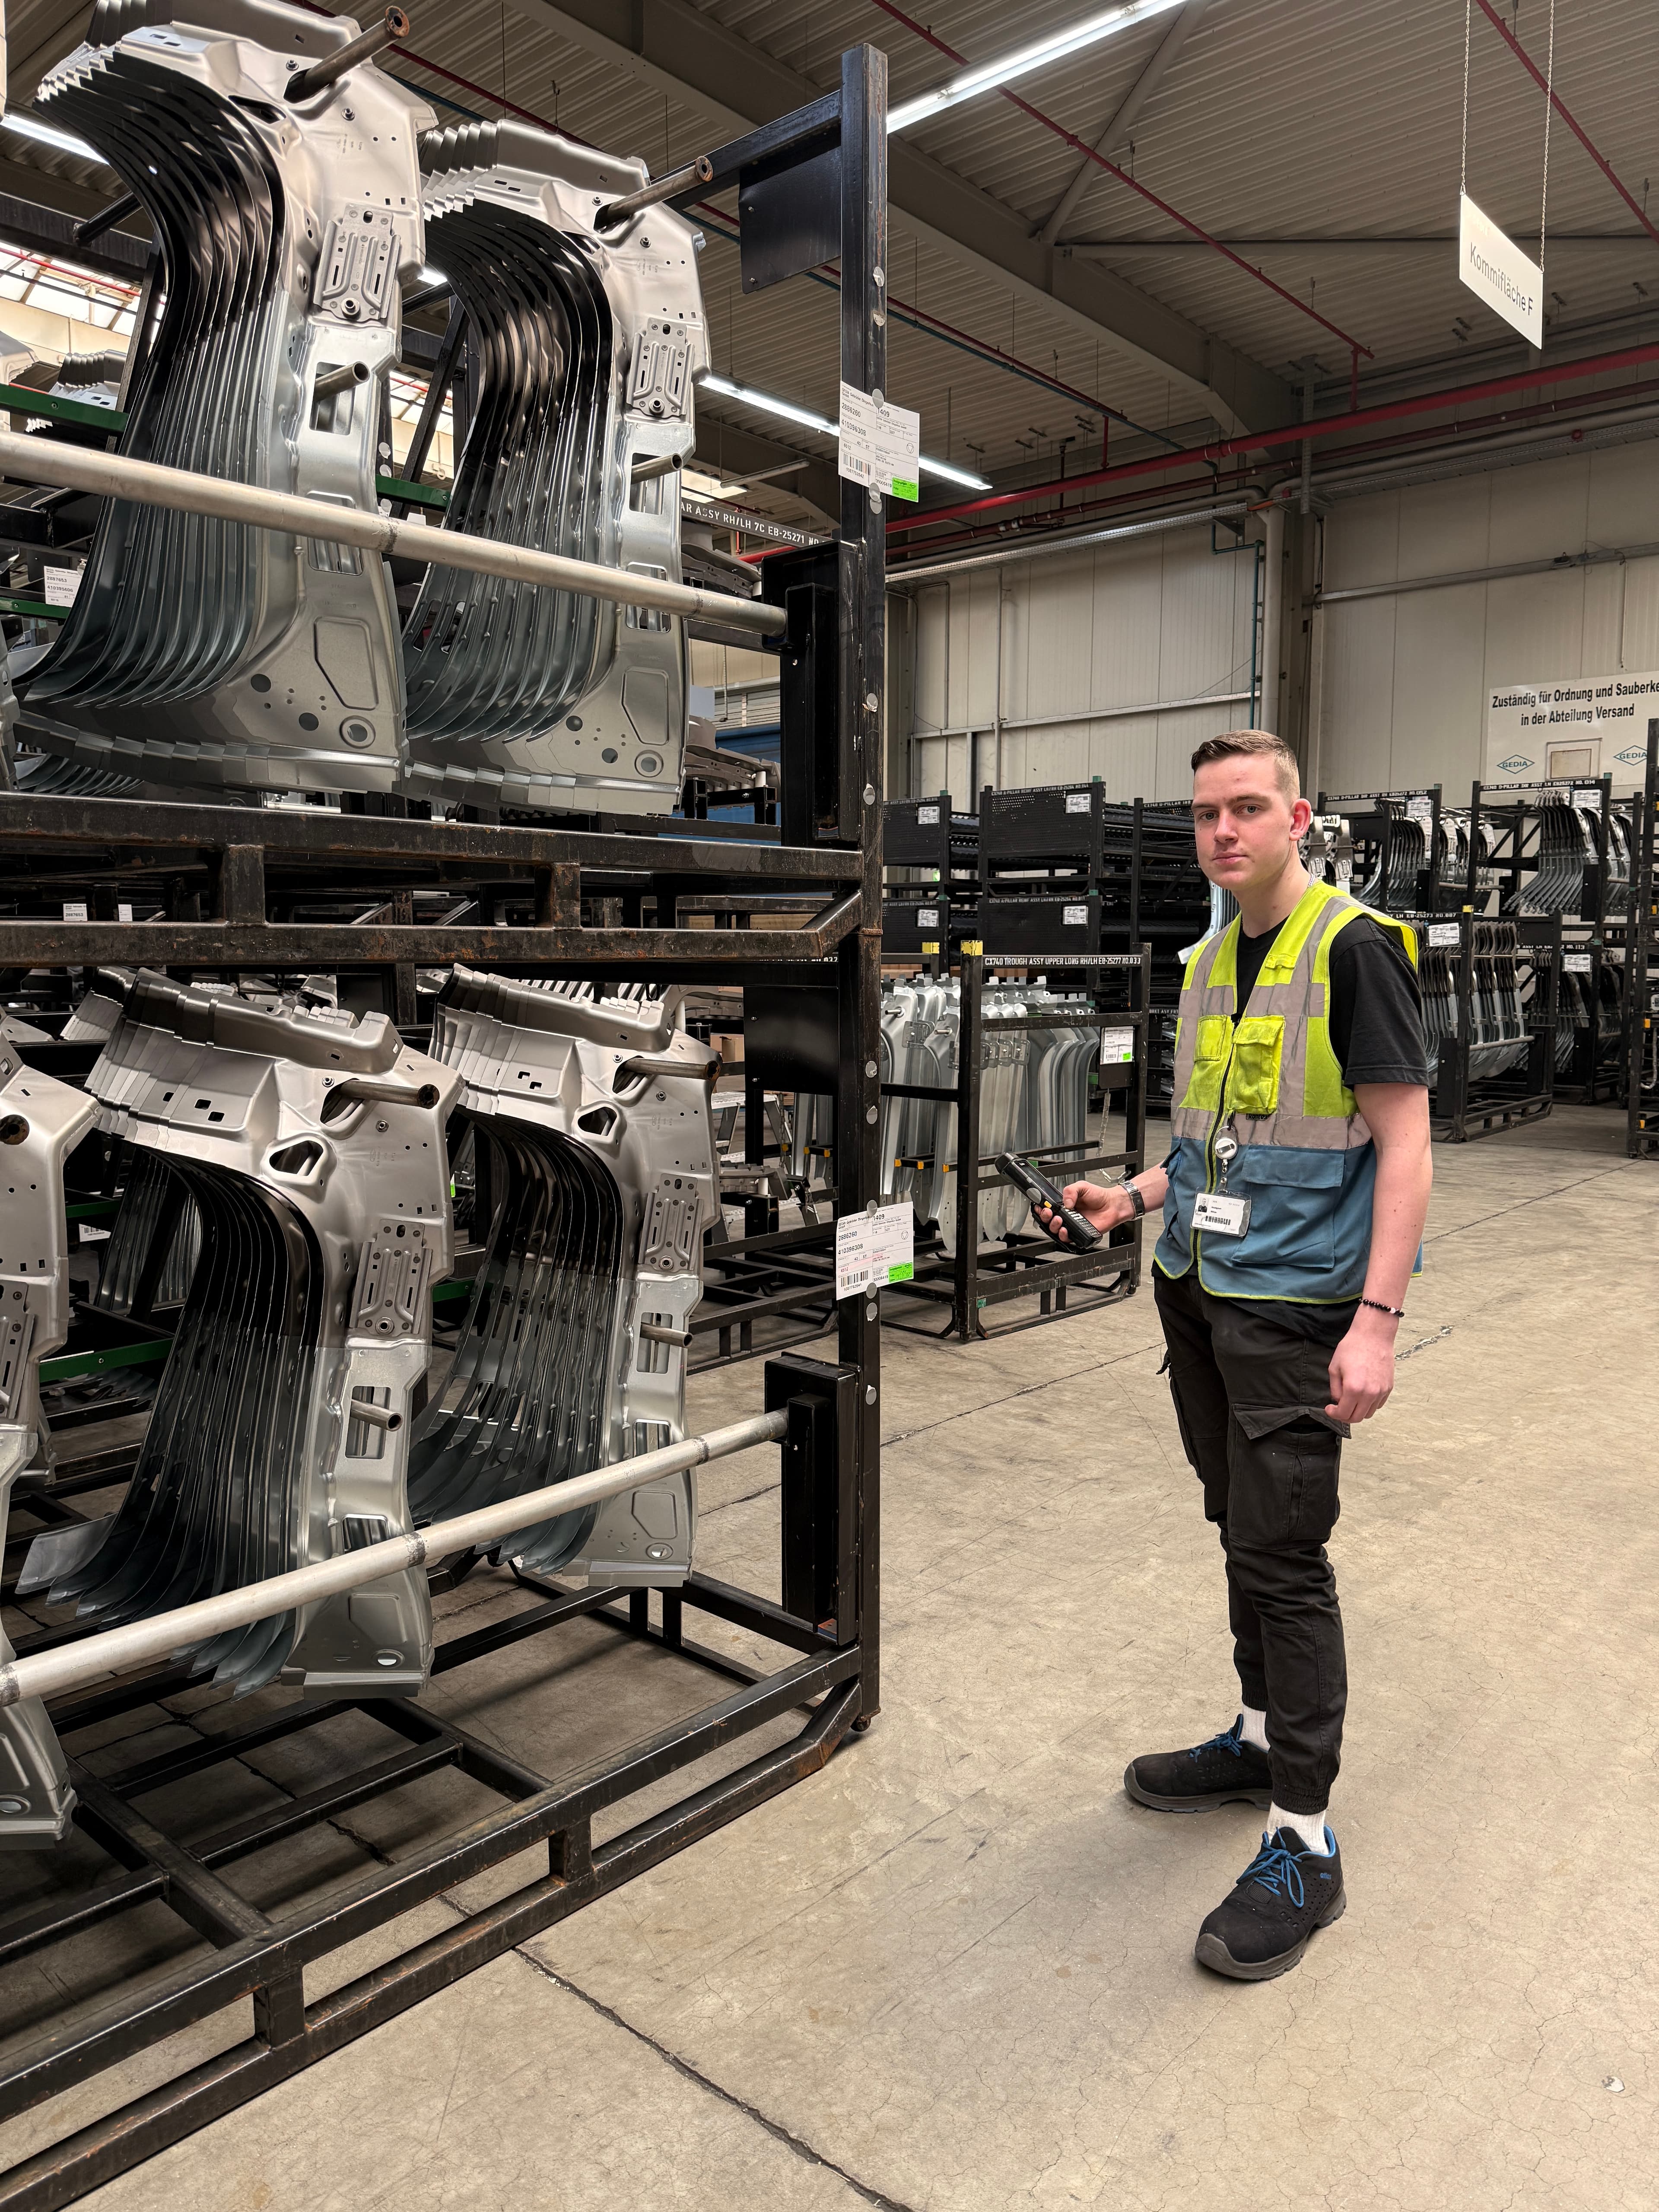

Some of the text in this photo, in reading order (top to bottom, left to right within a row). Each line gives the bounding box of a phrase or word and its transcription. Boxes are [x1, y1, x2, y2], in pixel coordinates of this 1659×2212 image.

[1471, 242, 1533, 315] Kommifläche F
[842, 403, 861, 417] 2886260
[877, 408, 890, 417] 1409
[842, 419, 866, 436] 410396308
[695, 506, 720, 520] ASSY
[723, 513, 751, 529] RH/LH
[754, 522, 765, 532] 7C
[768, 526, 804, 543] EB-25271
[1492, 693, 1536, 708] Zuständig
[1539, 691, 1551, 703] für
[1554, 688, 1592, 702] Ordnung
[1596, 684, 1613, 698] und
[1521, 703, 1634, 725] in der Abteilung Versand
[839, 1231, 857, 1241] 2886260
[838, 1243, 863, 1255] 410396308
